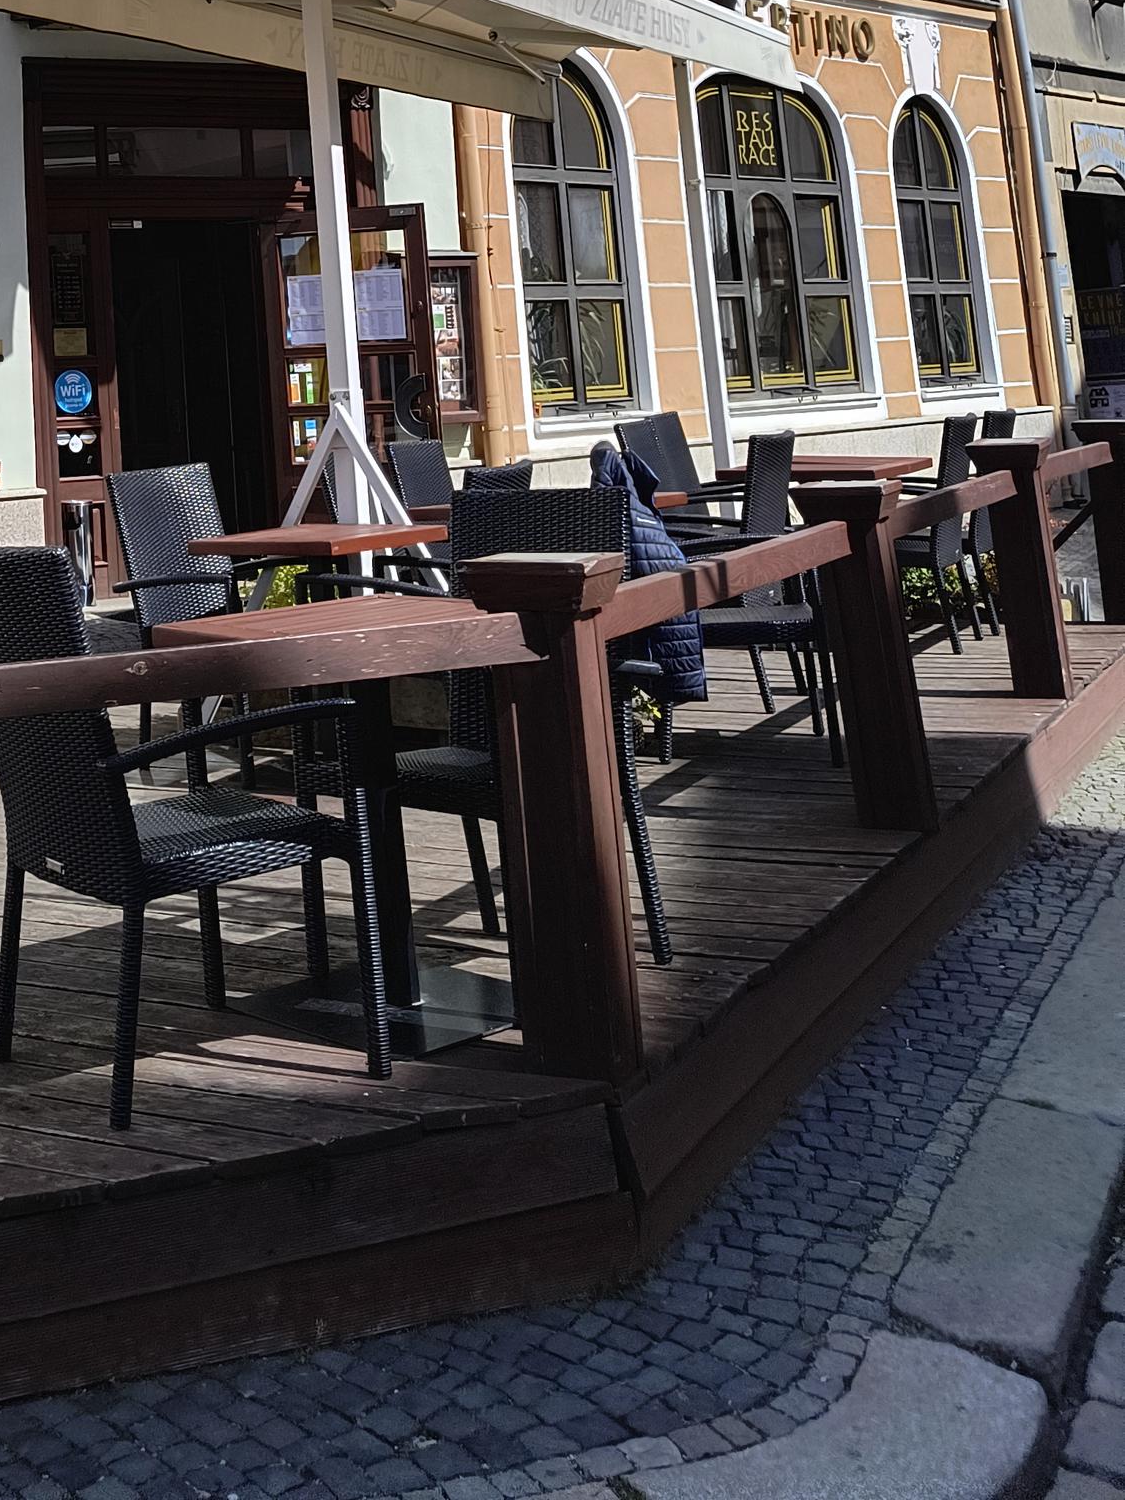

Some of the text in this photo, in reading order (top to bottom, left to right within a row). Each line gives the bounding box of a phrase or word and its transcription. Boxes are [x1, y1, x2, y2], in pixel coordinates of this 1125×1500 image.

[650, 8, 691, 48] HUSY
[739, 147, 777, 166] RACE
[60, 384, 86, 397] WiFi
